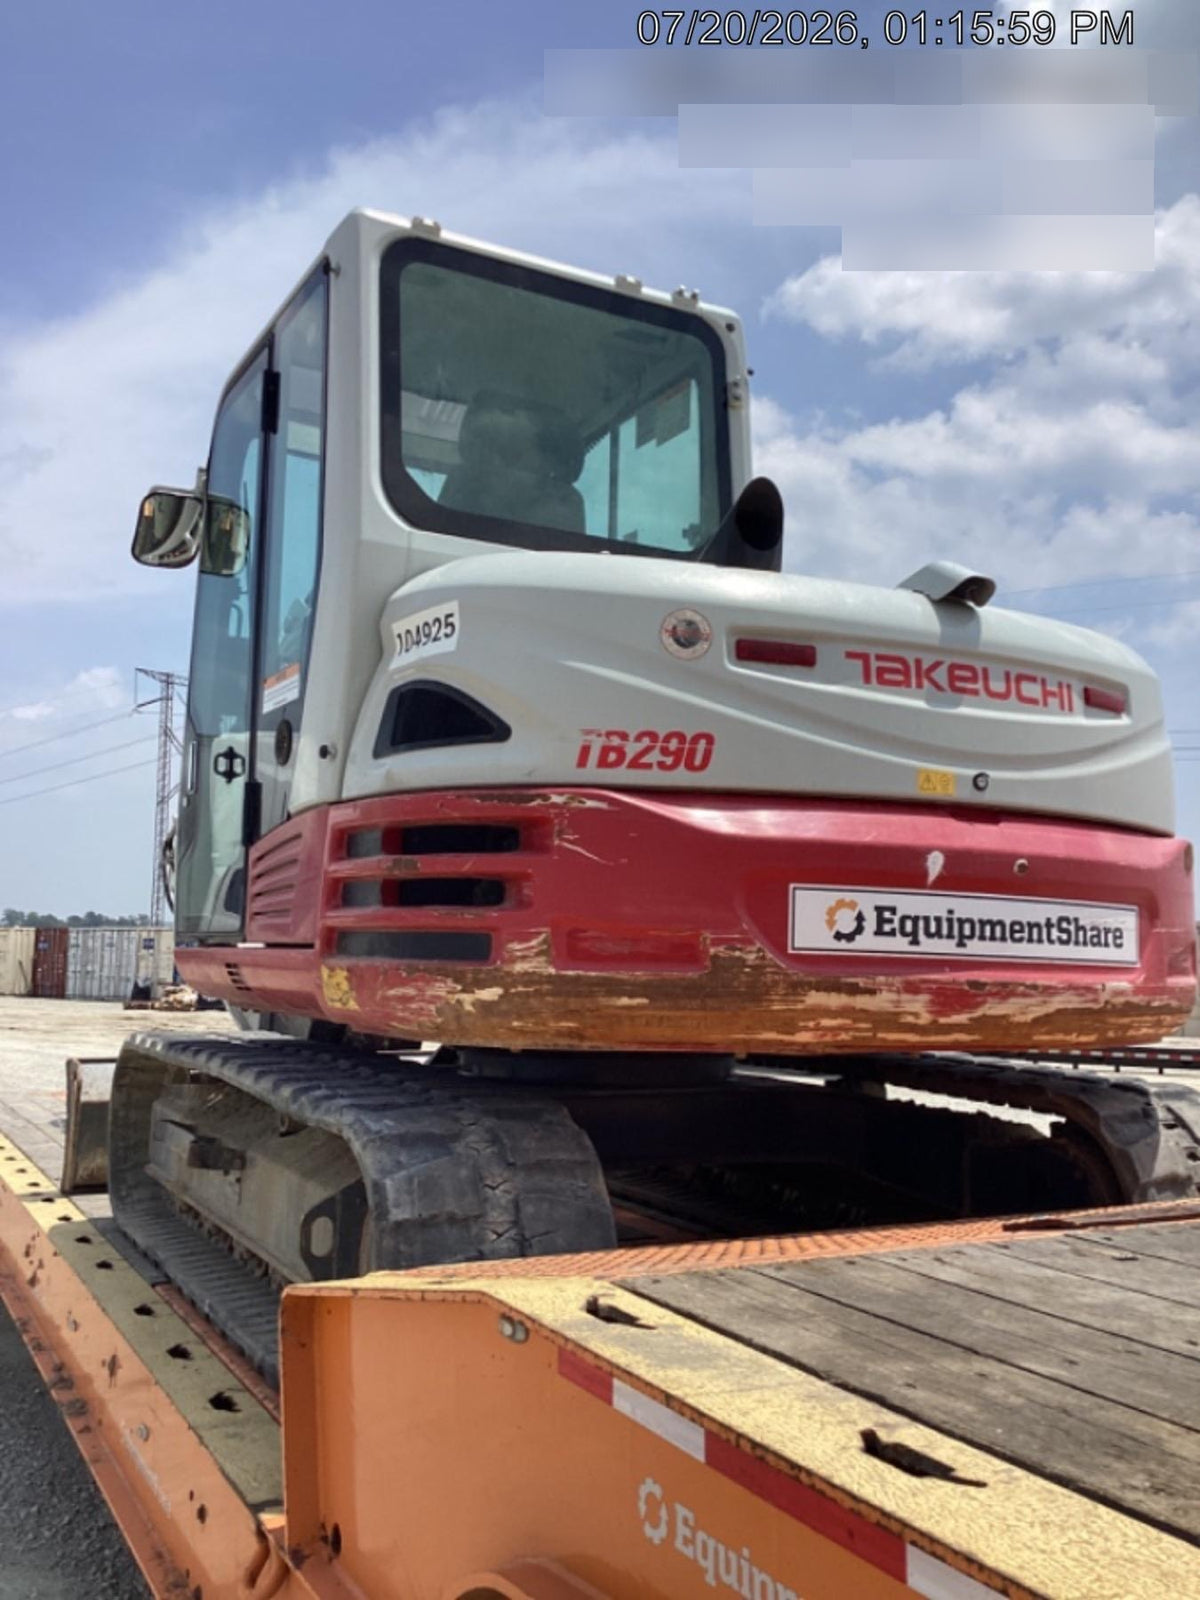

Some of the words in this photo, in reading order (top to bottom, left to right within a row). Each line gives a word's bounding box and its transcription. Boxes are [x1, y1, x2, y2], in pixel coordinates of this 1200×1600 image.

[396, 612, 456, 656] 104925
[575, 728, 715, 773] TB290
[873, 905, 1124, 949] EquipmentShare
